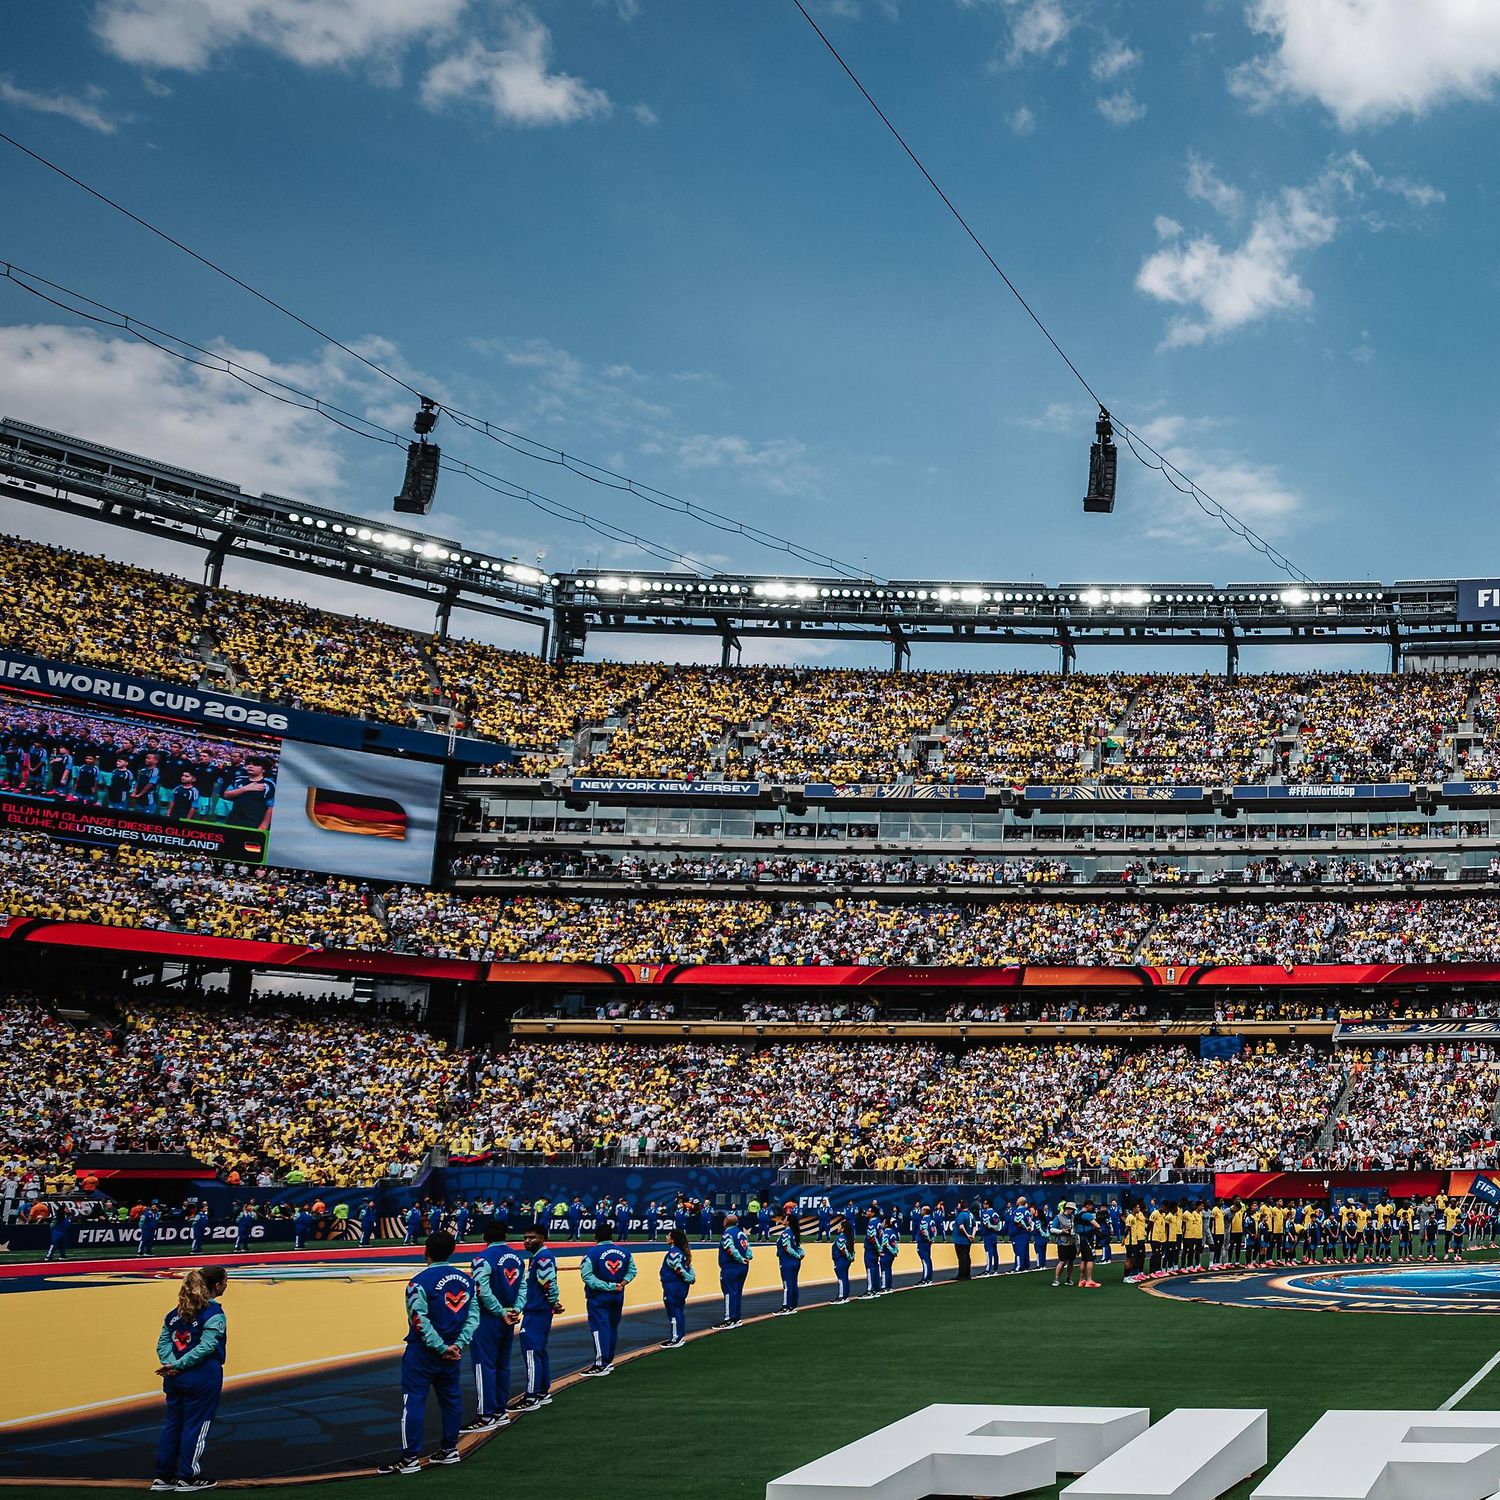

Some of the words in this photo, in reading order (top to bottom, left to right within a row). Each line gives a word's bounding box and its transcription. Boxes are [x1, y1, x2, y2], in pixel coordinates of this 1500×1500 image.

[0, 660, 41, 683] IFA
[47, 669, 145, 702] WORLD
[149, 691, 200, 712] CUP
[203, 701, 288, 730] 2026
[580, 781, 612, 790] NEW
[617, 782, 656, 791] YORK
[659, 783, 691, 792] NEW
[694, 784, 751, 793] JERSEY
[1288, 786, 1355, 798] #FIFAWorldCup
[43, 809, 59, 819] IM
[61, 812, 115, 827] GLANZE
[118, 820, 163, 834] DIESES
[58, 821, 139, 840] DEUTSCHES
[141, 833, 219, 851] VATERLAND!
[1475, 1180, 1497, 1197] FIFA
[800, 1196, 831, 1209] FIFA
[550, 1219, 570, 1230] IFA
[78, 1229, 115, 1243] FIFA
[118, 1227, 177, 1242] WOLD
[212, 1225, 265, 1239] 206
[434, 1274, 470, 1290] VOLUNTEER
